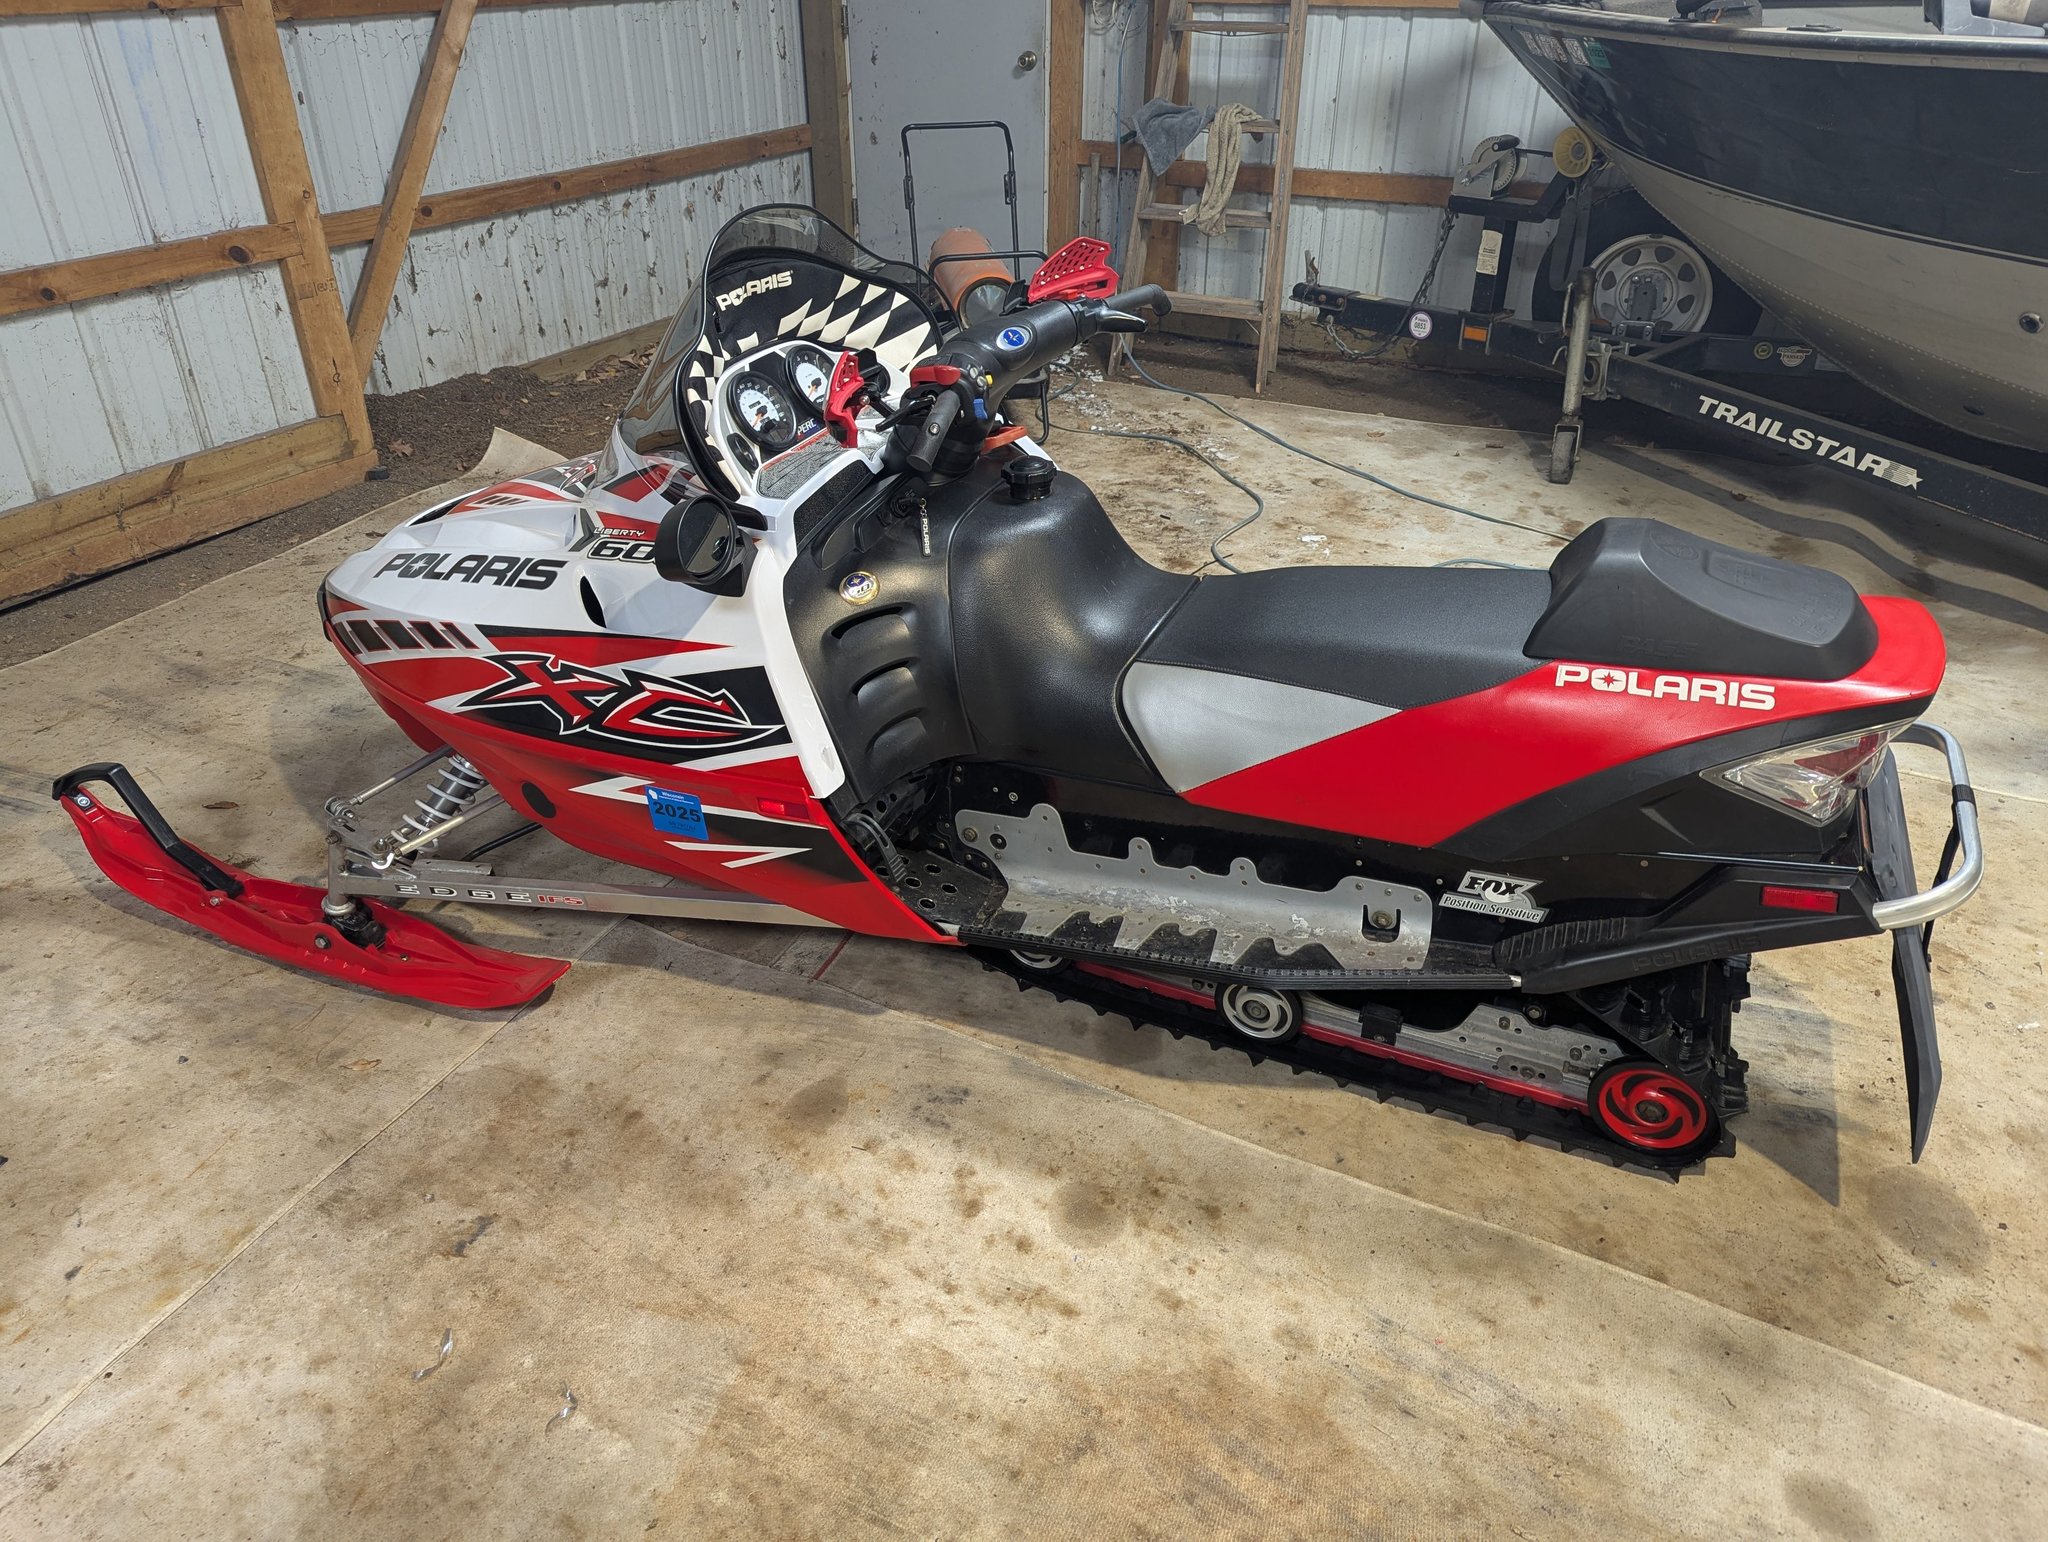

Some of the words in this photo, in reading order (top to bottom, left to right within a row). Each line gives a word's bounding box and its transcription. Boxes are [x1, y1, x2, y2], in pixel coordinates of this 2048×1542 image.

[716, 270, 794, 312] POLARIS
[797, 418, 817, 436] PERC
[1699, 395, 1894, 480] TRAILSTAR
[594, 527, 645, 537] LIBERTY
[922, 518, 931, 554] POLARIS
[372, 552, 569, 590] POLARIS
[1554, 664, 1776, 711] POLARIS
[653, 801, 702, 823] 2025
[394, 884, 533, 903] EDGE
[537, 894, 584, 906] IFS
[1464, 876, 1524, 896] FOX
[1443, 896, 1487, 912] Position
[1489, 903, 1540, 921] Sensitive
